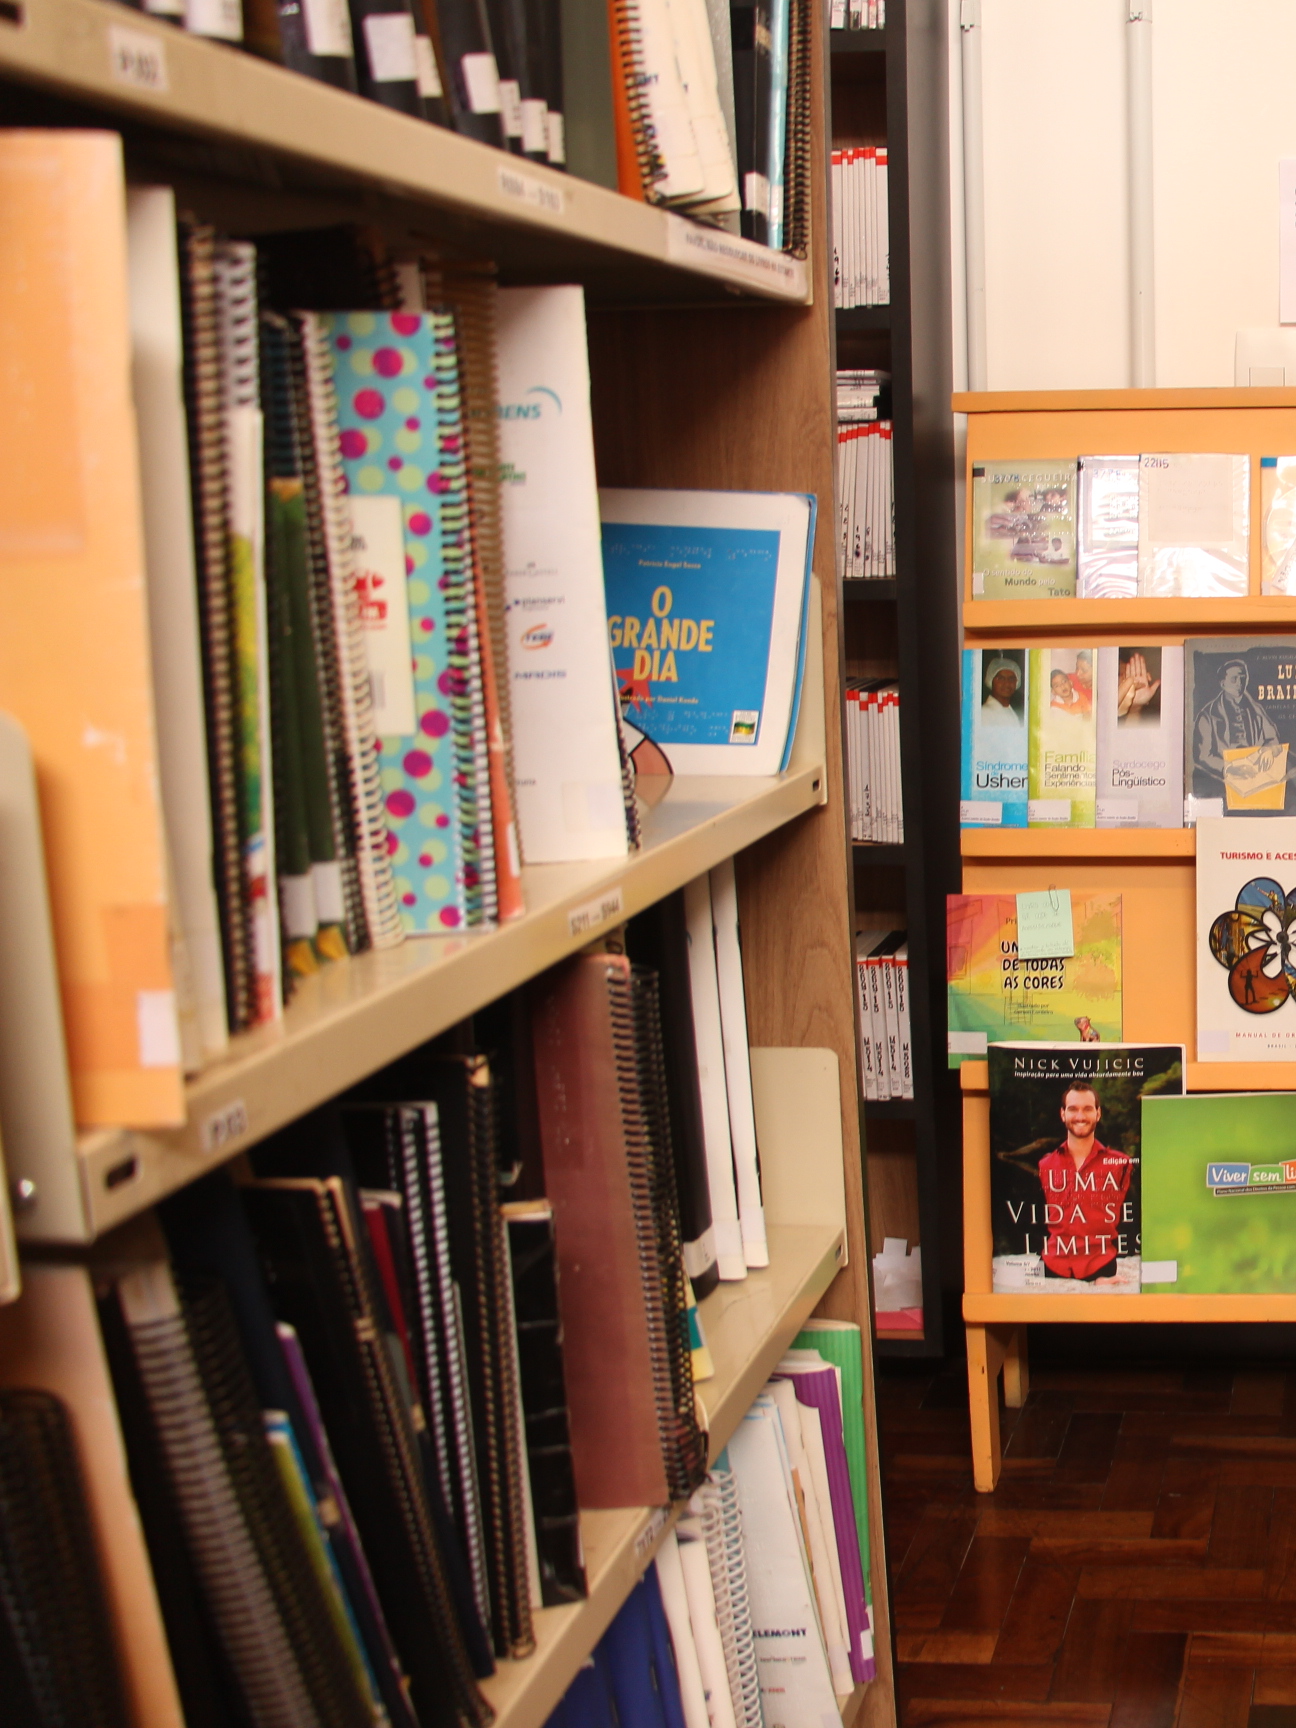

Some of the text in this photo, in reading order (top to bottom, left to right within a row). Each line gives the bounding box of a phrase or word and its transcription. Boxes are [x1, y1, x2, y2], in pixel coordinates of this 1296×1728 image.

[1004, 577, 1037, 586] Mundo
[1048, 588, 1071, 597] Tato
[651, 585, 673, 618] O
[608, 615, 715, 652] GRANDE
[633, 649, 679, 683] DIA
[976, 760, 1028, 771] Síndrome
[1044, 763, 1086, 772] Falando
[1112, 768, 1135, 778] Pós-
[976, 773, 1028, 789] Usher
[1220, 851, 1263, 860] TURISMO
[1266, 852, 1272, 860] E
[1002, 958, 1066, 972] DE TODAS
[1003, 975, 1064, 990] AS CORES
[1014, 1057, 1144, 1072] NICK VUJICIC
[1102, 1157, 1127, 1166] Edição
[1048, 1169, 1119, 1193] UMA
[1211, 1166, 1248, 1184] Viver
[1252, 1170, 1282, 1183] sem
[1006, 1201, 1087, 1224] VIDA
